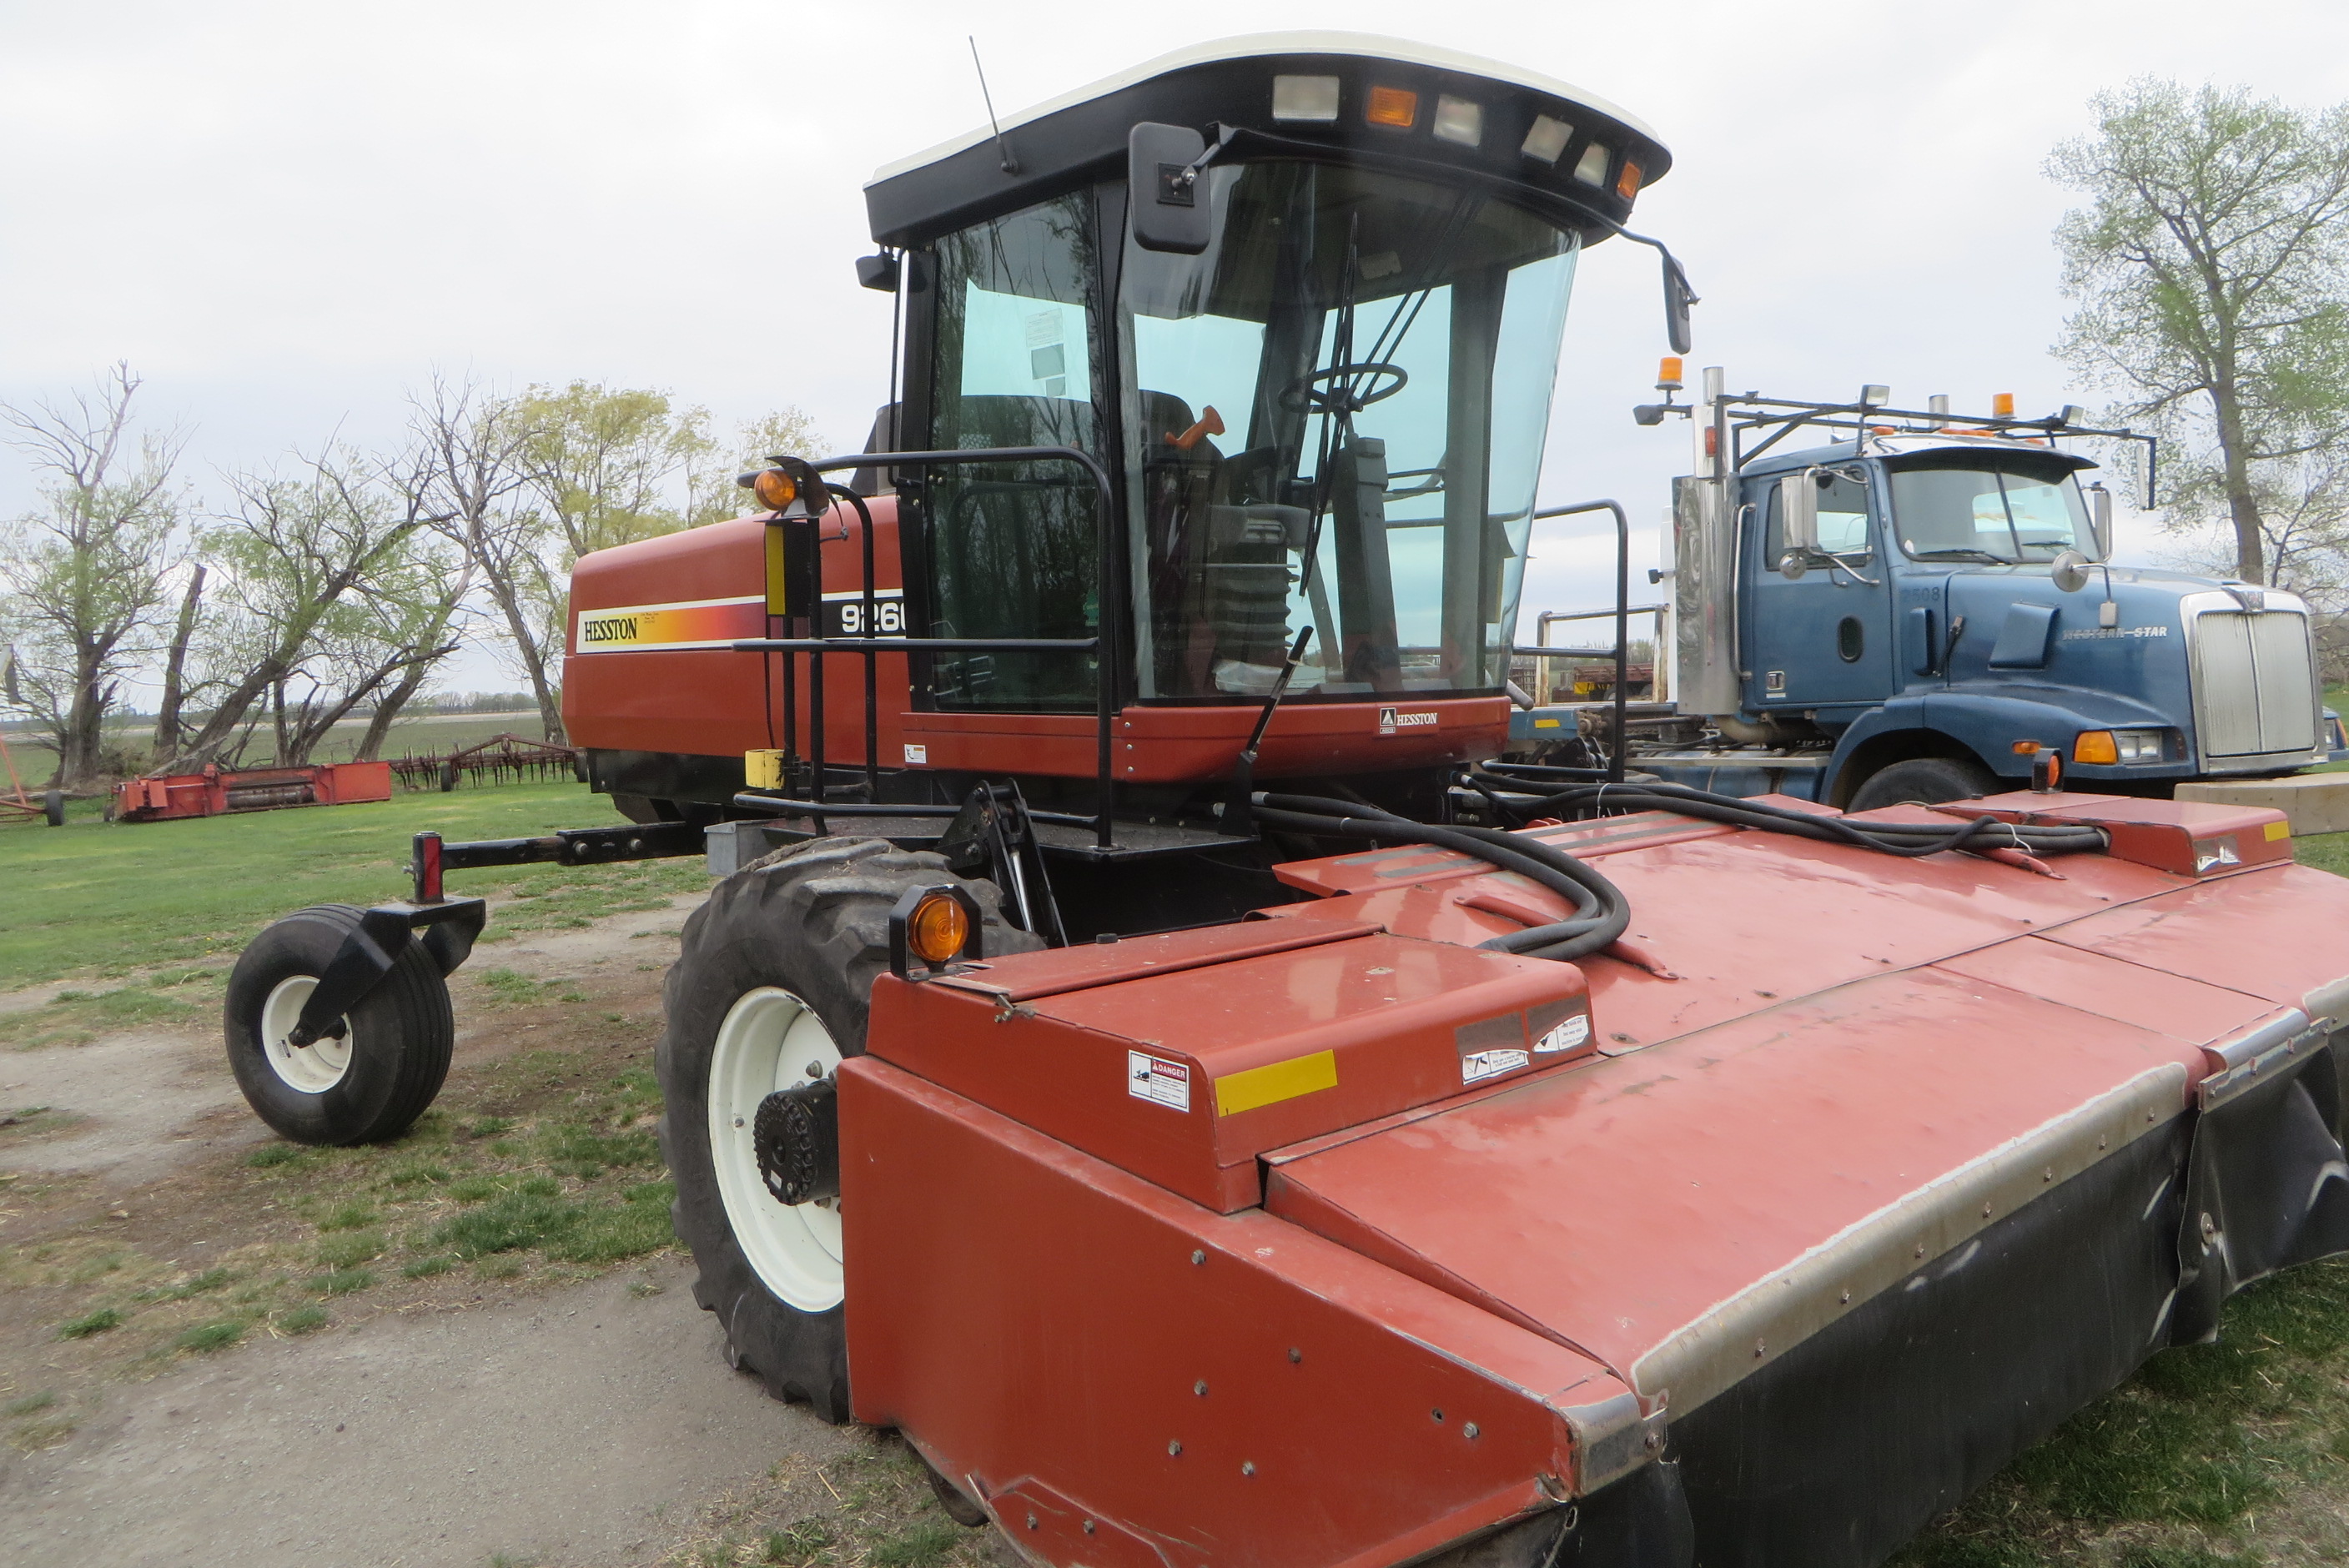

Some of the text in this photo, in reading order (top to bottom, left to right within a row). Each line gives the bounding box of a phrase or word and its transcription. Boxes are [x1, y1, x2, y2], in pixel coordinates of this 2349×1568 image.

[842, 602, 906, 632] 96
[585, 618, 637, 641] HESSTON
[2062, 626, 2167, 641] WESTERN STAR
[1396, 713, 1438, 726] HESSTON
[1158, 1065, 1185, 1078] DANGER
